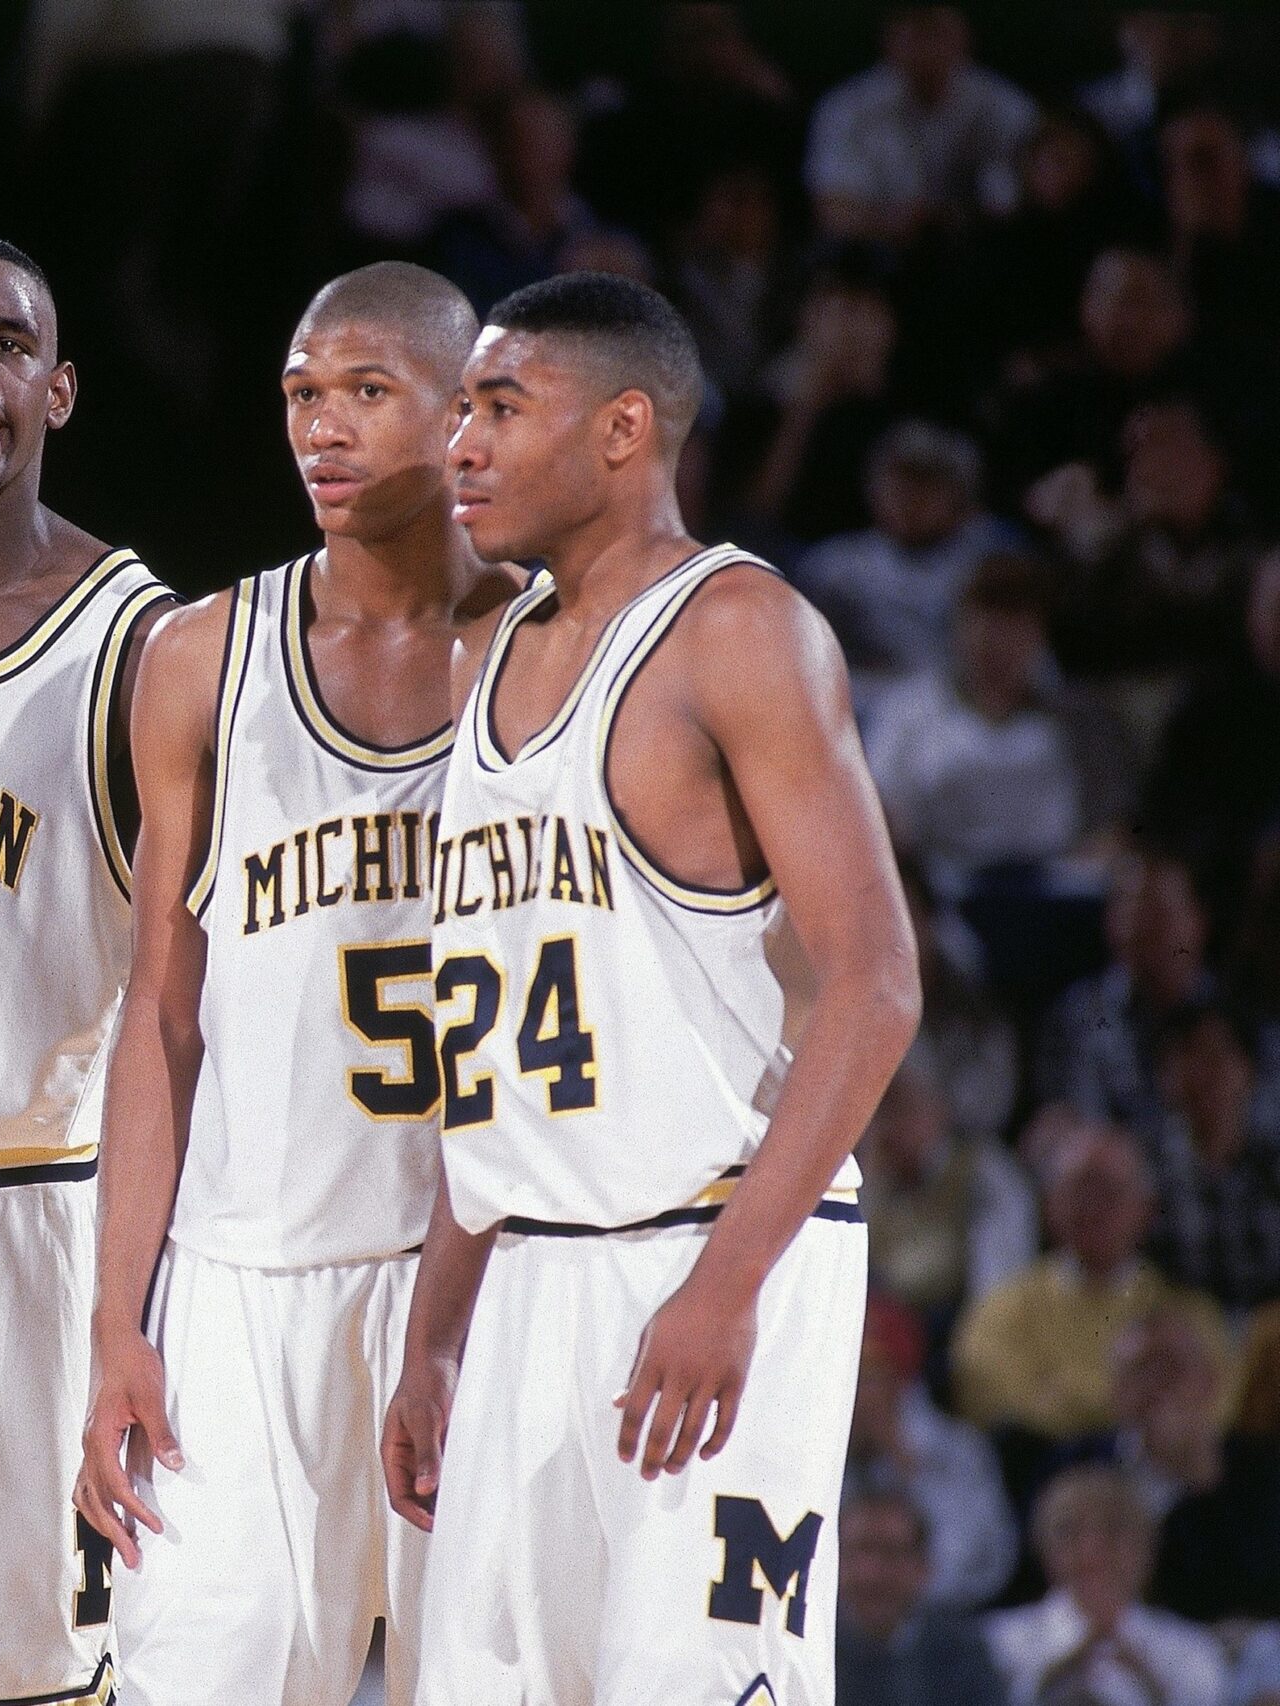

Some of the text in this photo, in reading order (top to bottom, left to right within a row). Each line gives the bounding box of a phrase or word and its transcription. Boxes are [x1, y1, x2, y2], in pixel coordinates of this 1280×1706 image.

[243, 811, 440, 934] MICHI
[338, 939, 441, 1122] 5
[435, 931, 602, 1134] 24
[708, 1494, 824, 1638] M
